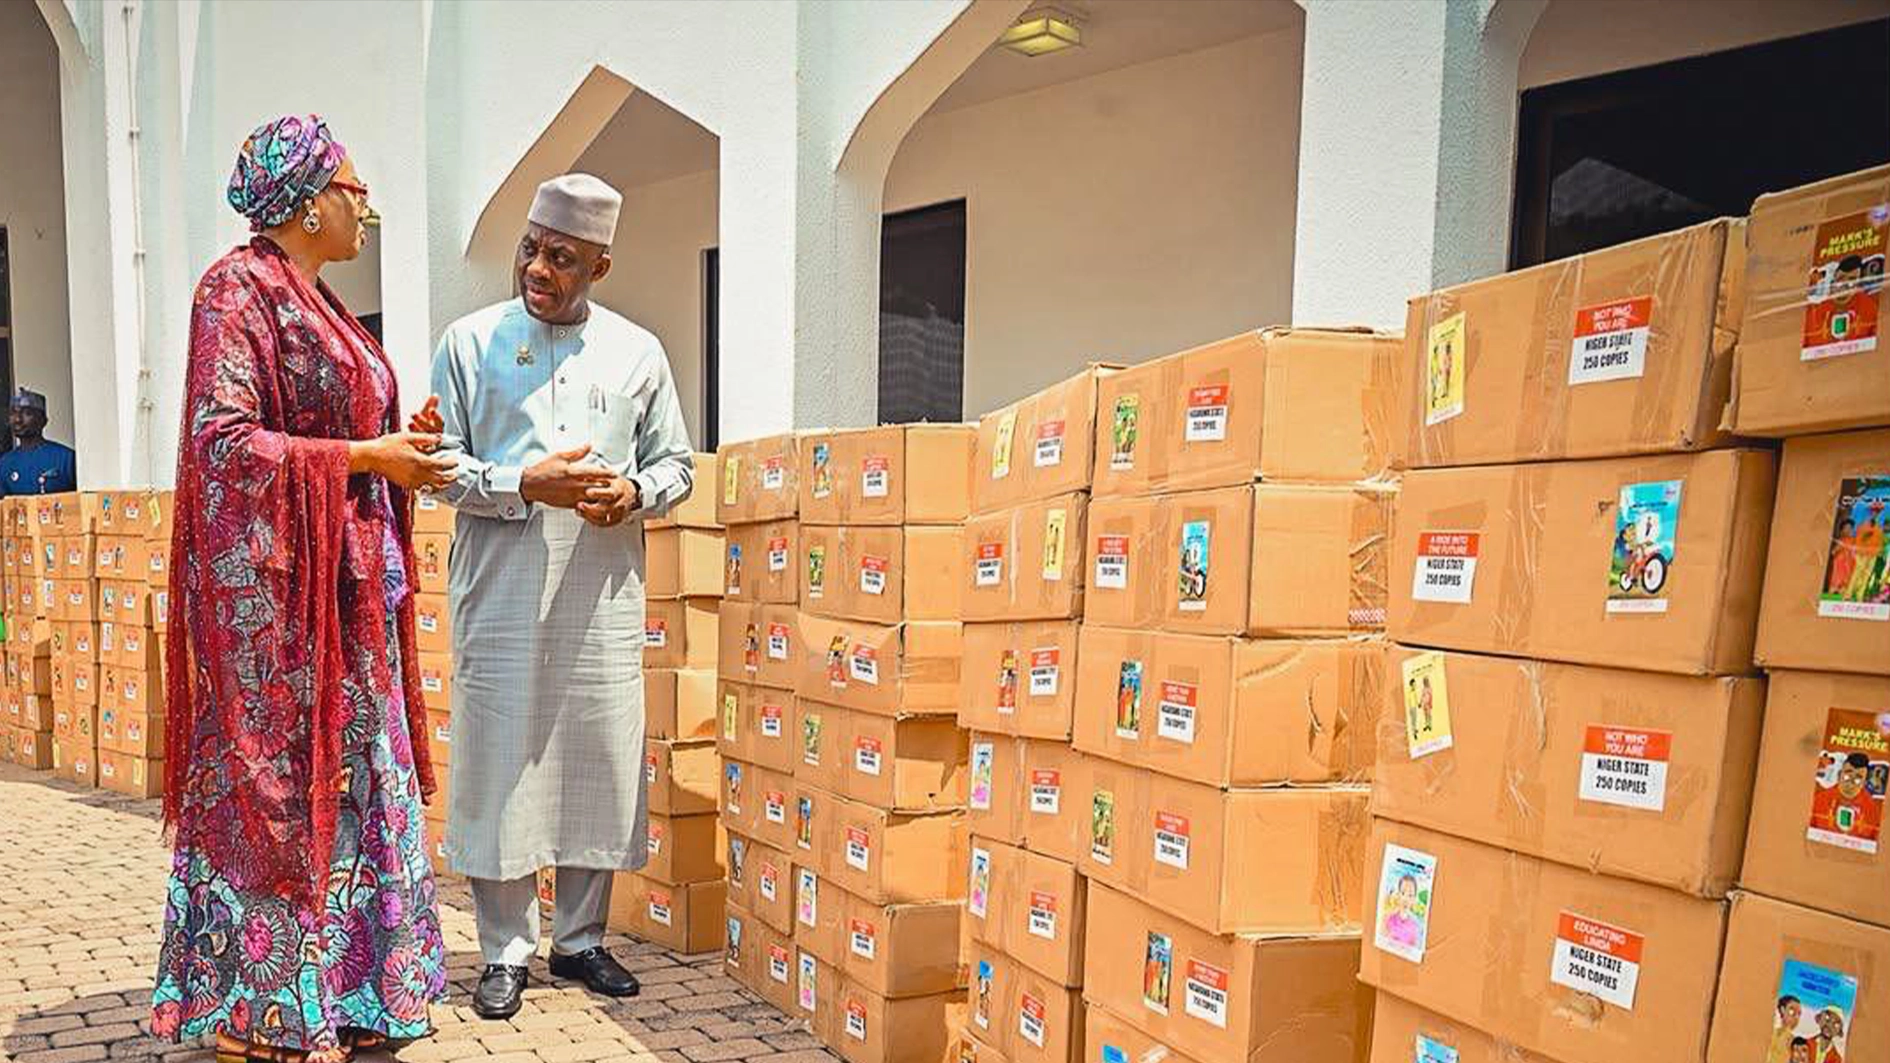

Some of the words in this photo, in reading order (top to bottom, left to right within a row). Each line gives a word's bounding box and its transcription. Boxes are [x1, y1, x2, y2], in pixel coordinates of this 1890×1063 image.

[1829, 227, 1874, 245] MARK'S
[1820, 236, 1881, 258] PRESSURE
[1585, 336, 1607, 350] NIGER
[1583, 355, 1599, 370] 250
[1600, 351, 1629, 367] COPIES
[1427, 559, 1445, 570] NIGER
[1446, 559, 1465, 570] STATE
[1425, 573, 1438, 585] 250
[1439, 574, 1461, 586] COPIES
[1605, 731, 1624, 741] NOT
[1625, 734, 1648, 746] WHO
[1839, 727, 1881, 739] MARK'S
[1604, 743, 1624, 754] YOU
[1625, 745, 1645, 757] ARE
[1830, 735, 1889, 752] PRESSURE
[1597, 758, 1622, 773] NIGER
[1624, 761, 1649, 776] STATE
[1596, 775, 1613, 790] 250
[1615, 778, 1647, 794] COPIES
[1574, 920, 1626, 945] EDUCATING
[1584, 935, 1611, 952] LINDA
[1570, 946, 1595, 964] NIGER
[1597, 954, 1622, 973] STATE
[1568, 963, 1586, 978] 250
[1587, 969, 1618, 990] COPIES
